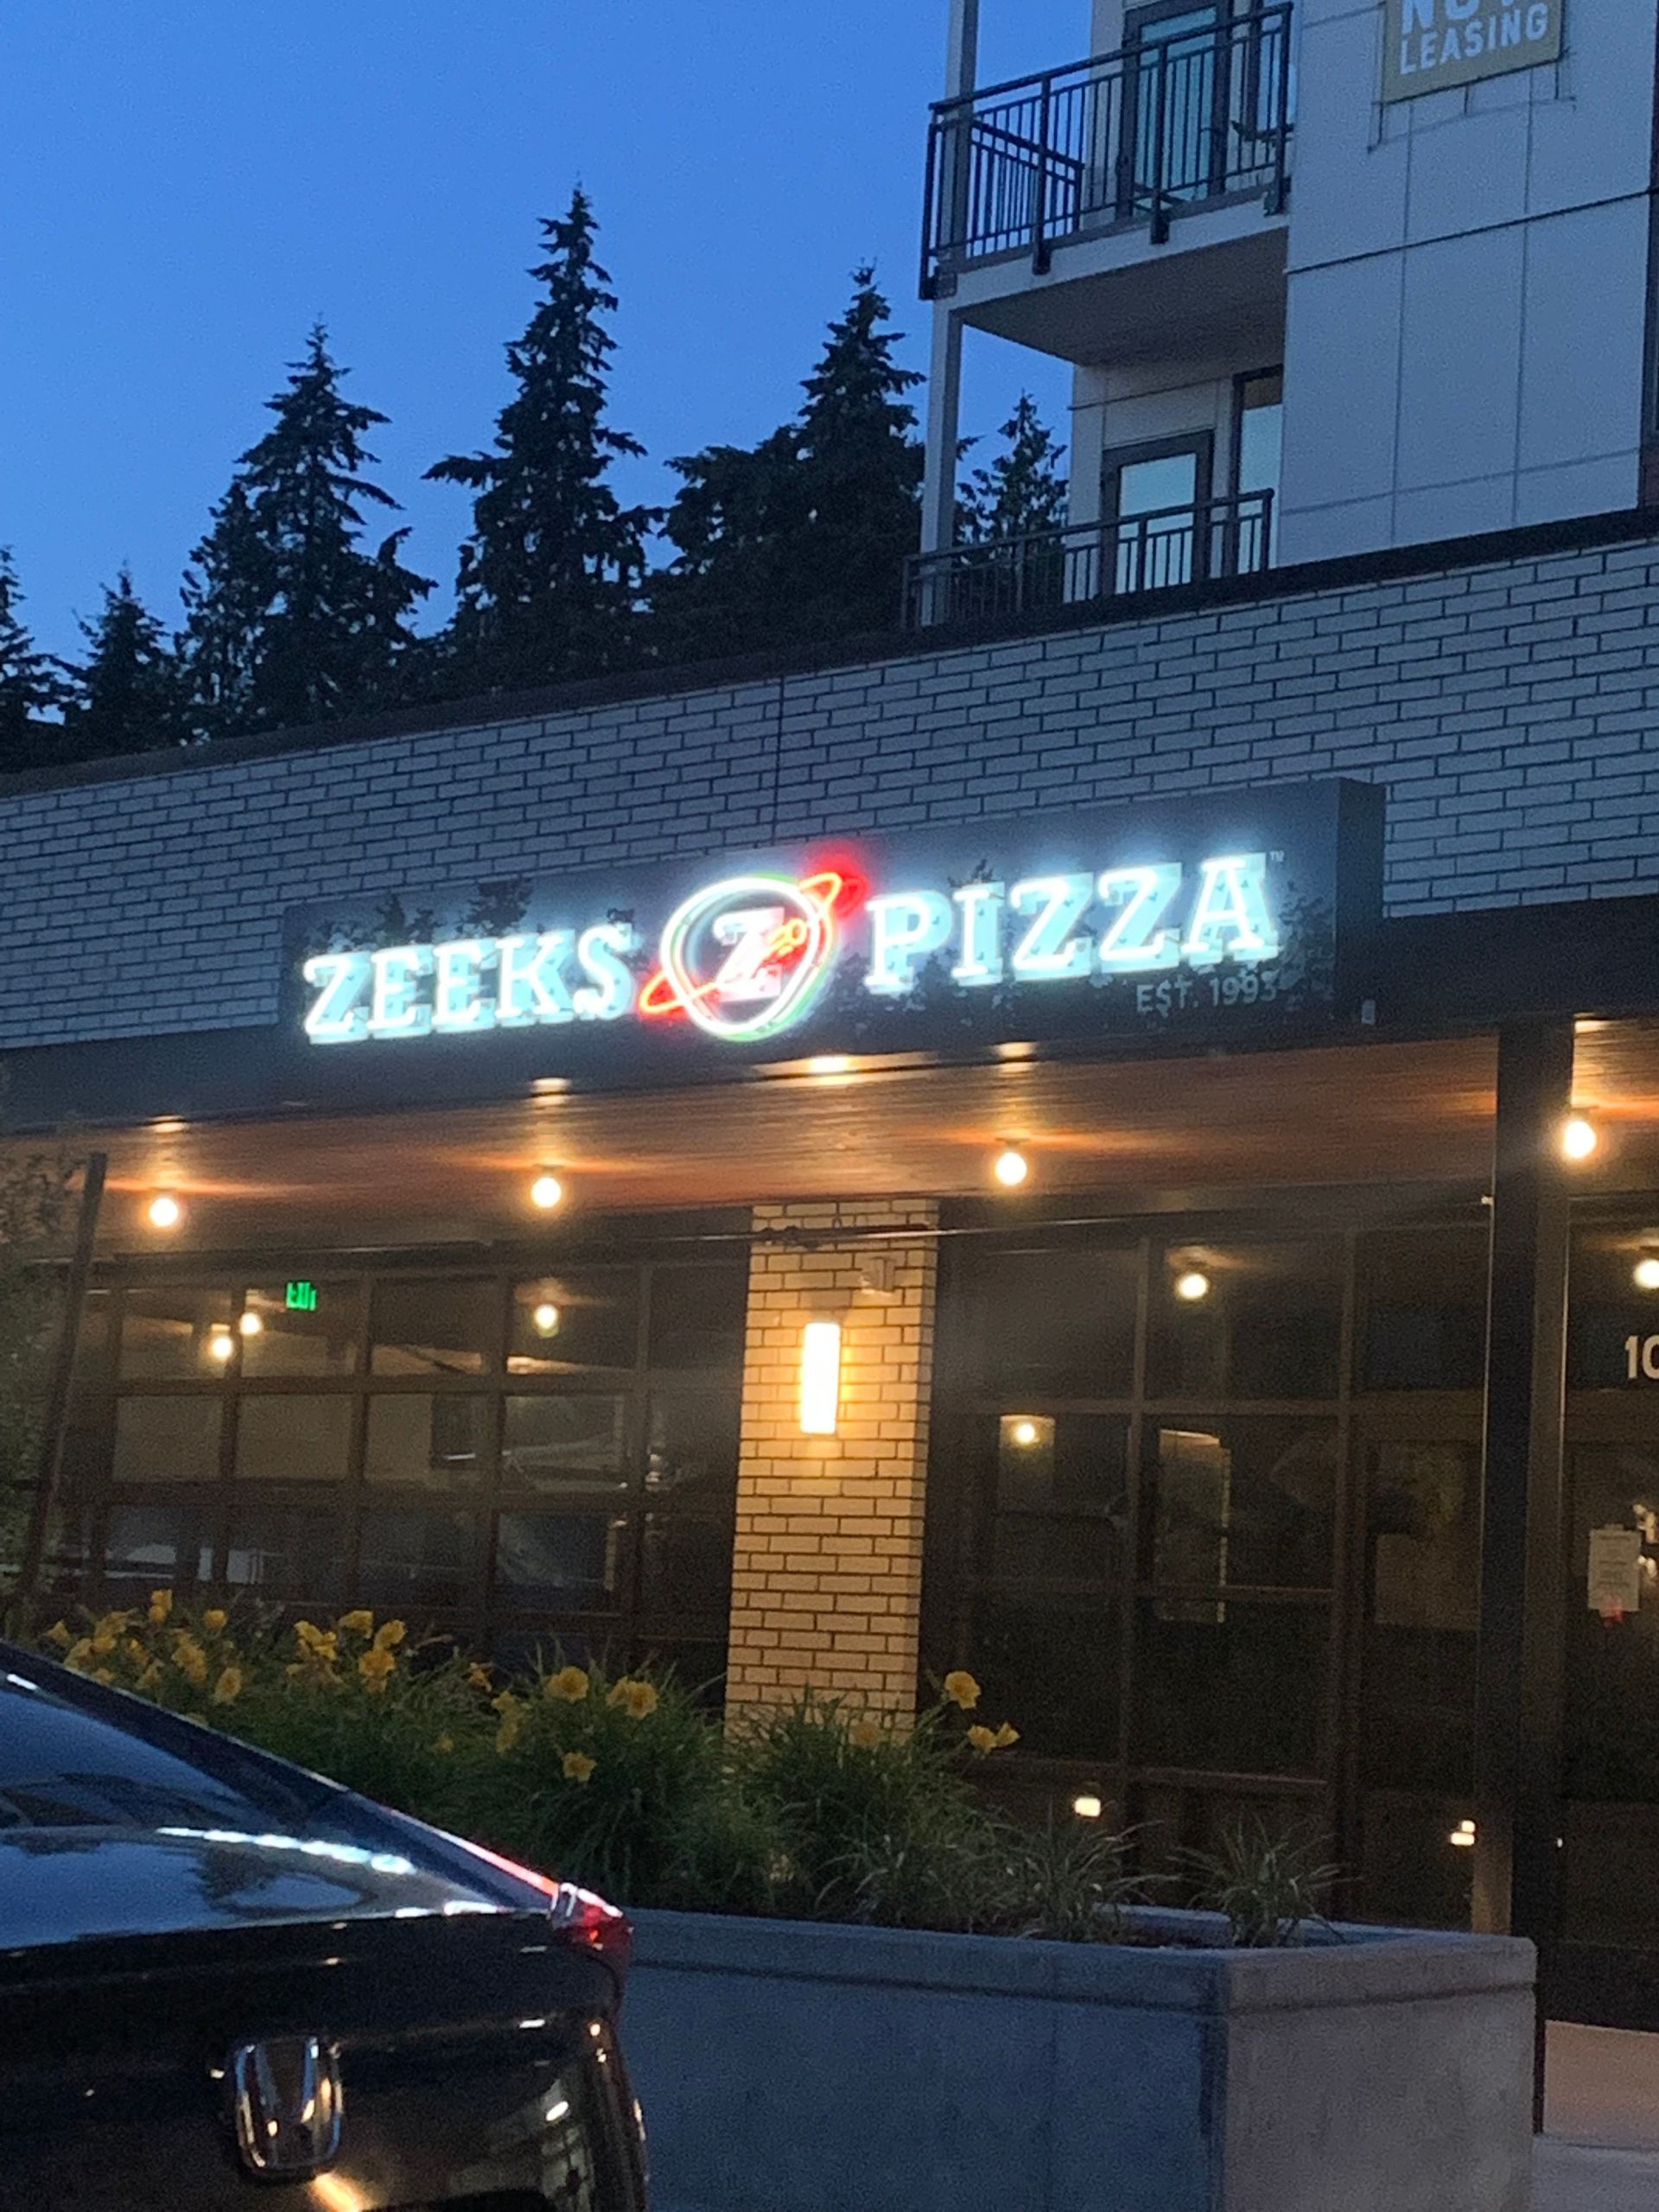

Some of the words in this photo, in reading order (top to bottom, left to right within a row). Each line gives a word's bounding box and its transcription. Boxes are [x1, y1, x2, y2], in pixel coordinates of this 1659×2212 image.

[1401, 3, 1549, 74] LEASING
[303, 925, 633, 1044] ZEEKS
[864, 852, 1280, 995] PIZZA
[1210, 970, 1278, 1007] 1993
